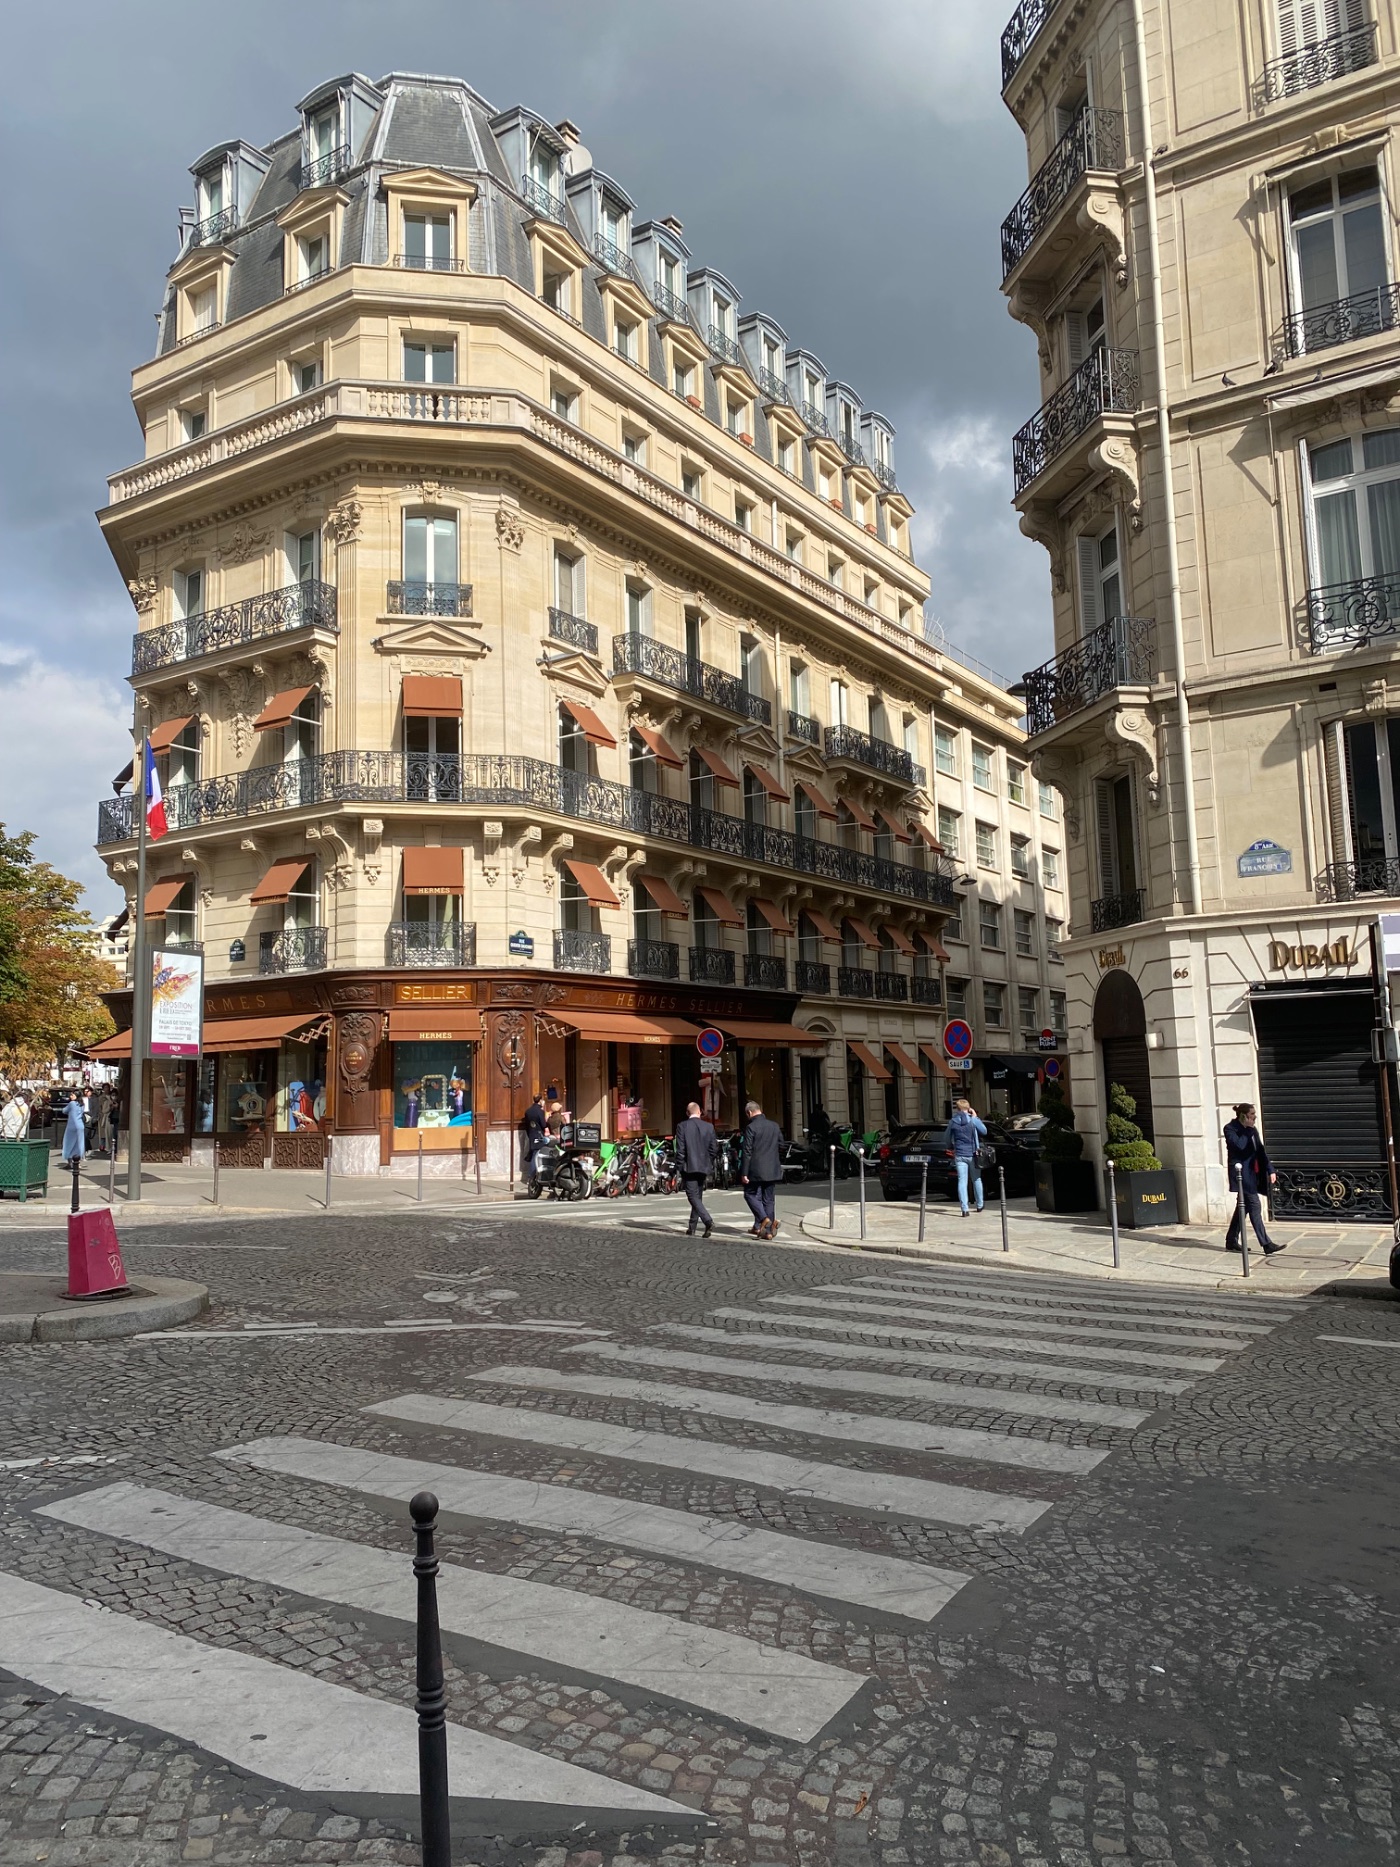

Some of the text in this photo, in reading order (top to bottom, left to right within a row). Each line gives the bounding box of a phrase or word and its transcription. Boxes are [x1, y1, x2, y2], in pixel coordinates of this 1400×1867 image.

[1267, 935, 1359, 970] DUBAIL
[1173, 968, 1188, 979] 66
[401, 985, 468, 1000] SELLIER
[689, 998, 743, 1014] SELLIER
[1141, 1193, 1167, 1202] DUBAIL
